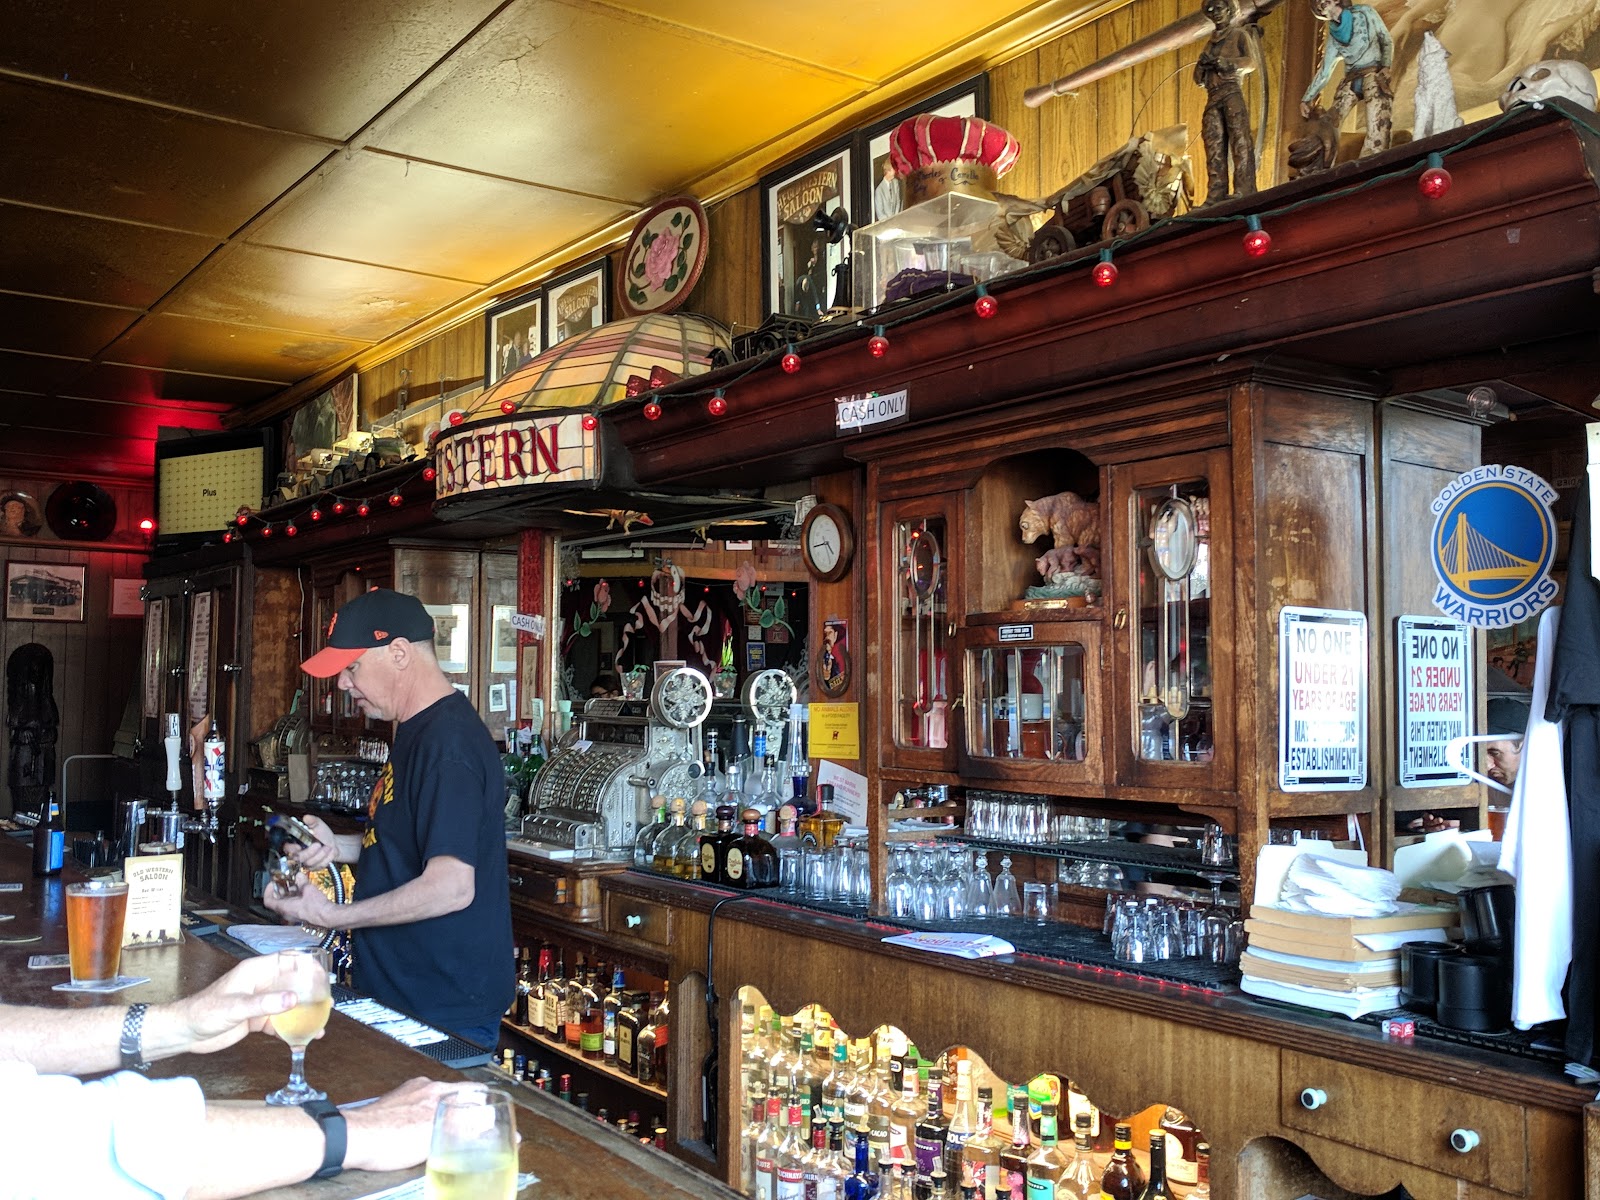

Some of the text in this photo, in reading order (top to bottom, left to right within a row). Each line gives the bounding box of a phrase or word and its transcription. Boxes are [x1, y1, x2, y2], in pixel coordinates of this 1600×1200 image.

[783, 185, 824, 221] SALOON
[564, 295, 591, 320] SALOON
[878, 395, 906, 417] ONLY
[202, 488, 217, 497] Plus
[1432, 467, 1555, 513] GOLDEN STATE
[1435, 578, 1556, 626] WARRIORS
[1297, 628, 1351, 655] NO ONE
[1294, 661, 1354, 686] UNDER 21
[1292, 688, 1322, 712] YEARS
[1339, 690, 1357, 712] AGE
[1291, 747, 1357, 771] ESTABLISHMENT
[133, 867, 174, 878] OLD WESTERN
[140, 872, 168, 882] SALOON
[871, 1129, 888, 1138] CACAO
